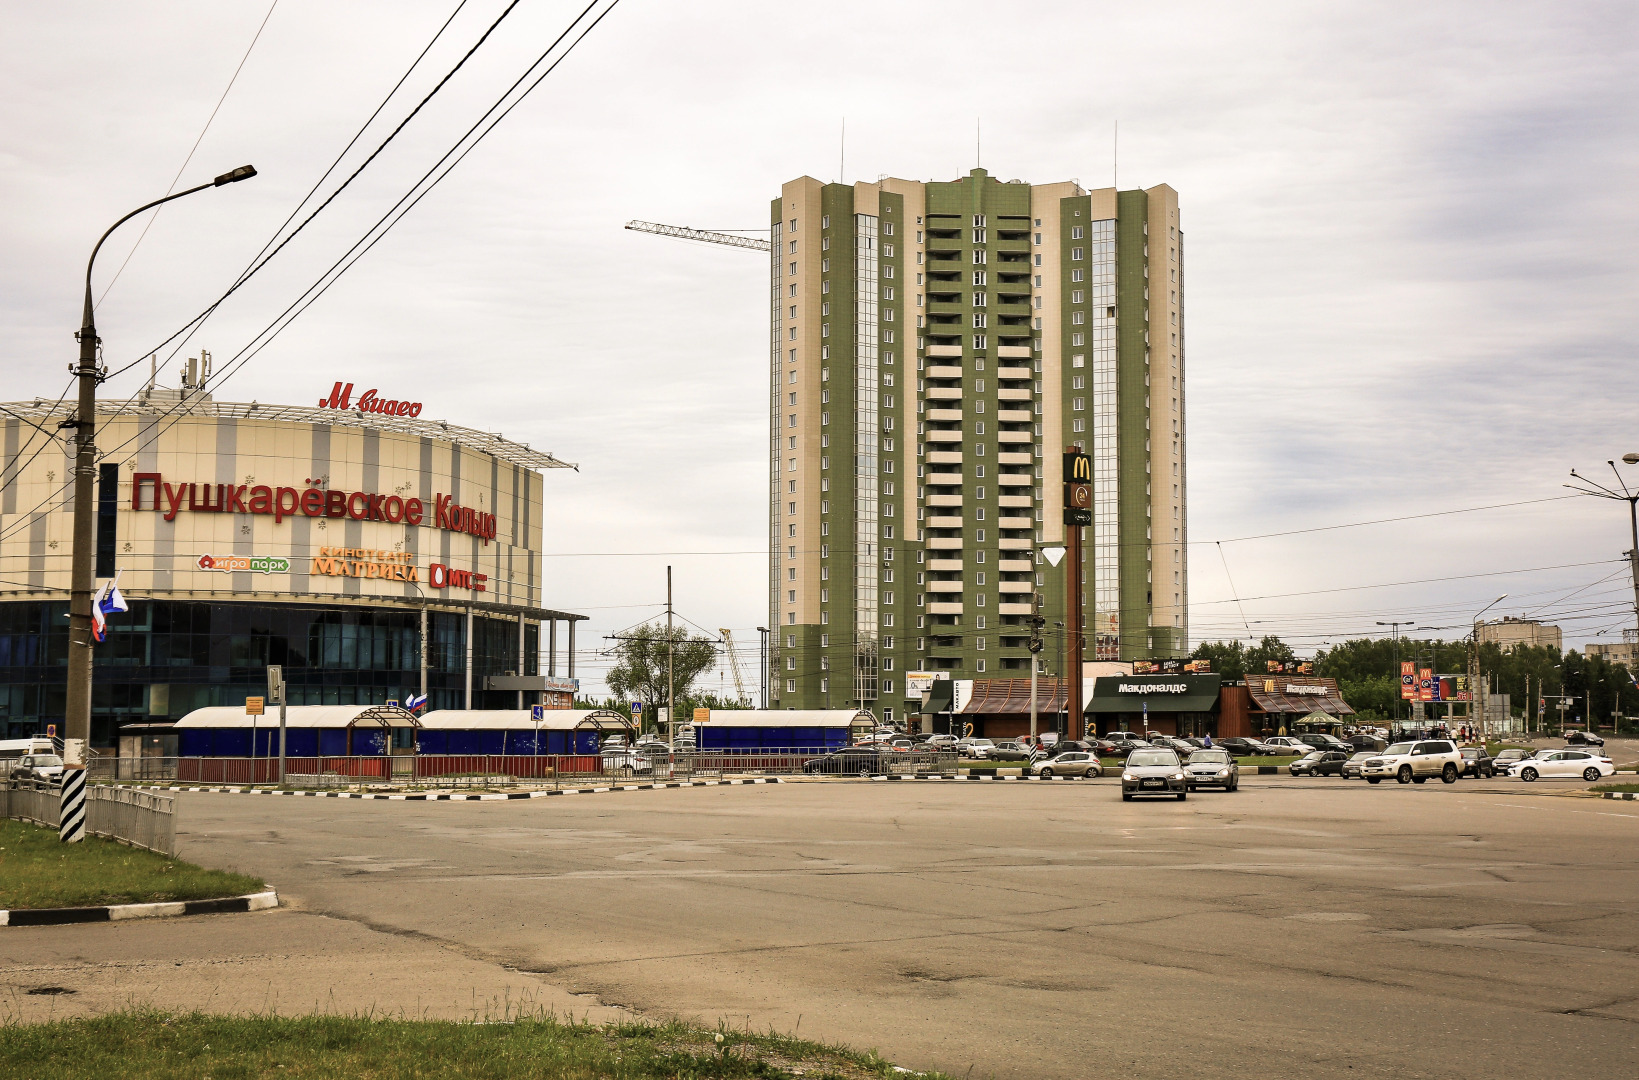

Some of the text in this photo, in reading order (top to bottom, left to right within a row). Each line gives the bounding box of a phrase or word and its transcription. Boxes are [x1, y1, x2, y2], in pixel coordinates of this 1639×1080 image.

[131, 472, 497, 546] Пушкарёвское Кольцо
[320, 547, 414, 562] КИНОТЕАТР
[448, 568, 472, 589] МТС
[1118, 683, 1187, 694] Макдоналдс
